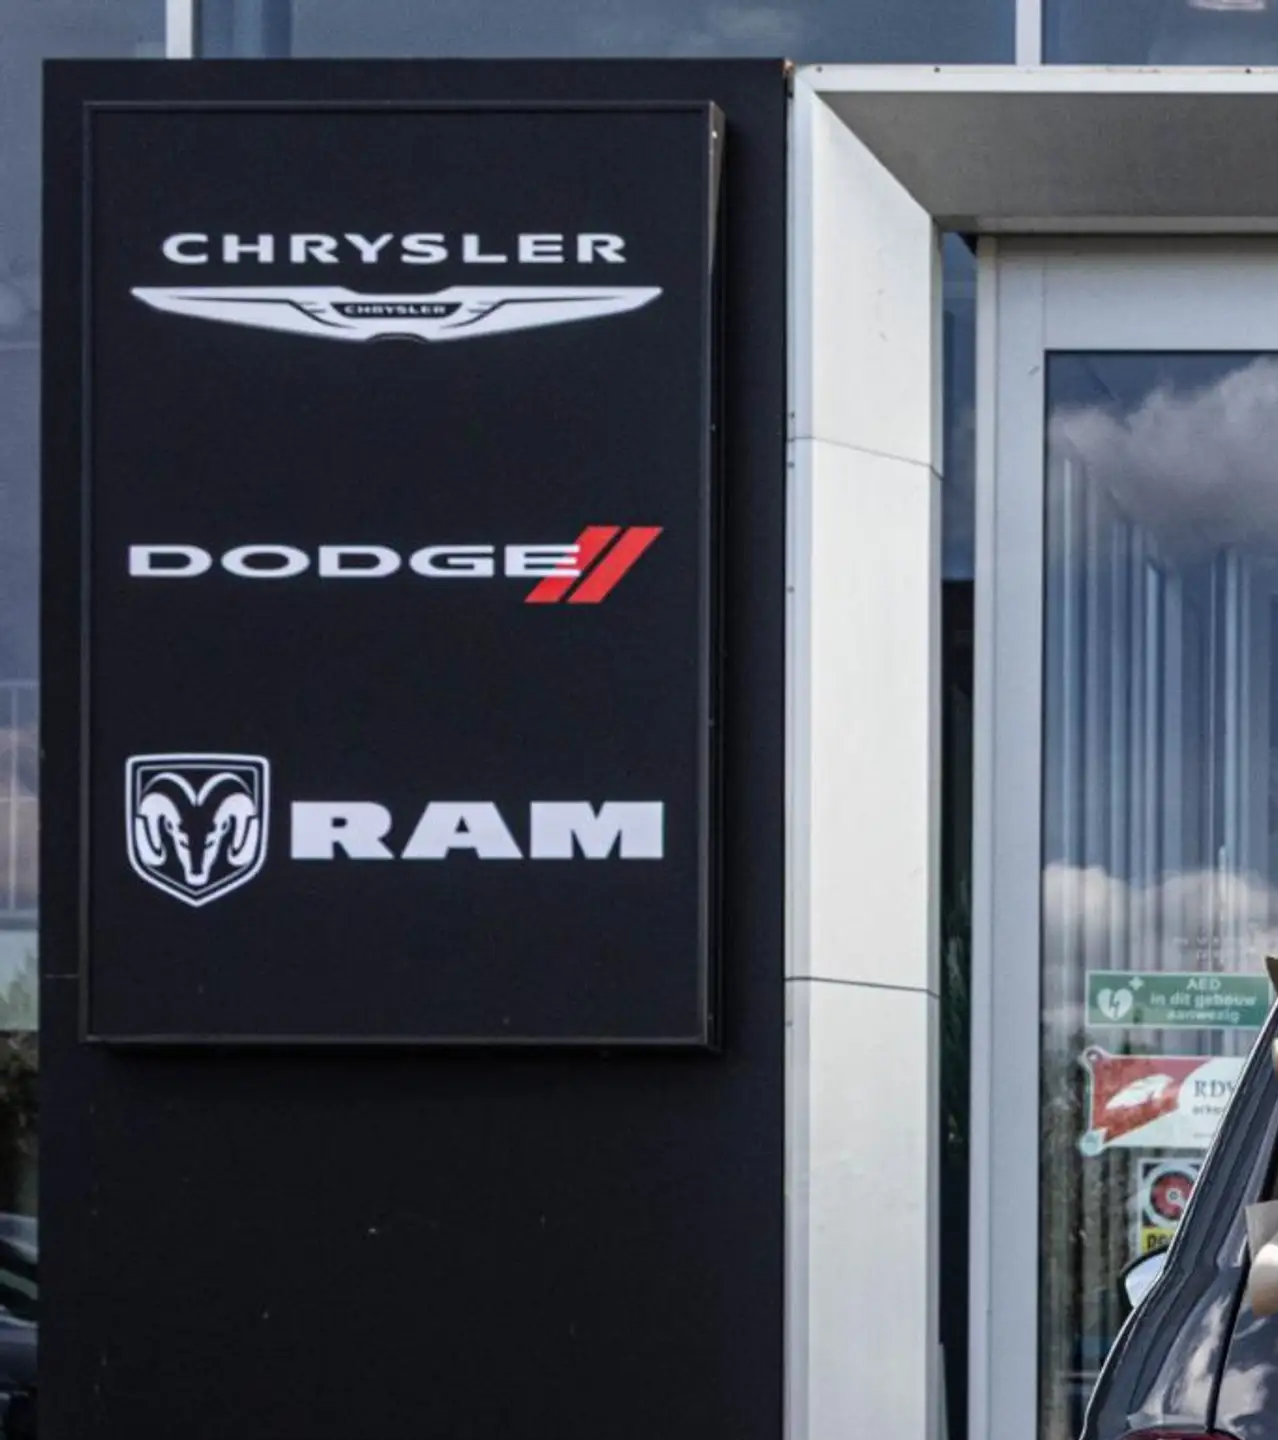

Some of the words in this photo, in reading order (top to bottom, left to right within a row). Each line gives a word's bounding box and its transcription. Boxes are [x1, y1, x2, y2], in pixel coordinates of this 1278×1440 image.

[162, 233, 627, 264] CHRYSLER
[343, 303, 446, 315] CHRYSLER
[129, 543, 582, 579] DODGE
[290, 800, 664, 860] RAM
[1186, 977, 1222, 991] AED
[1151, 992, 1166, 1005] in
[1170, 991, 1192, 1005] dit
[1194, 992, 1258, 1008] gebouw
